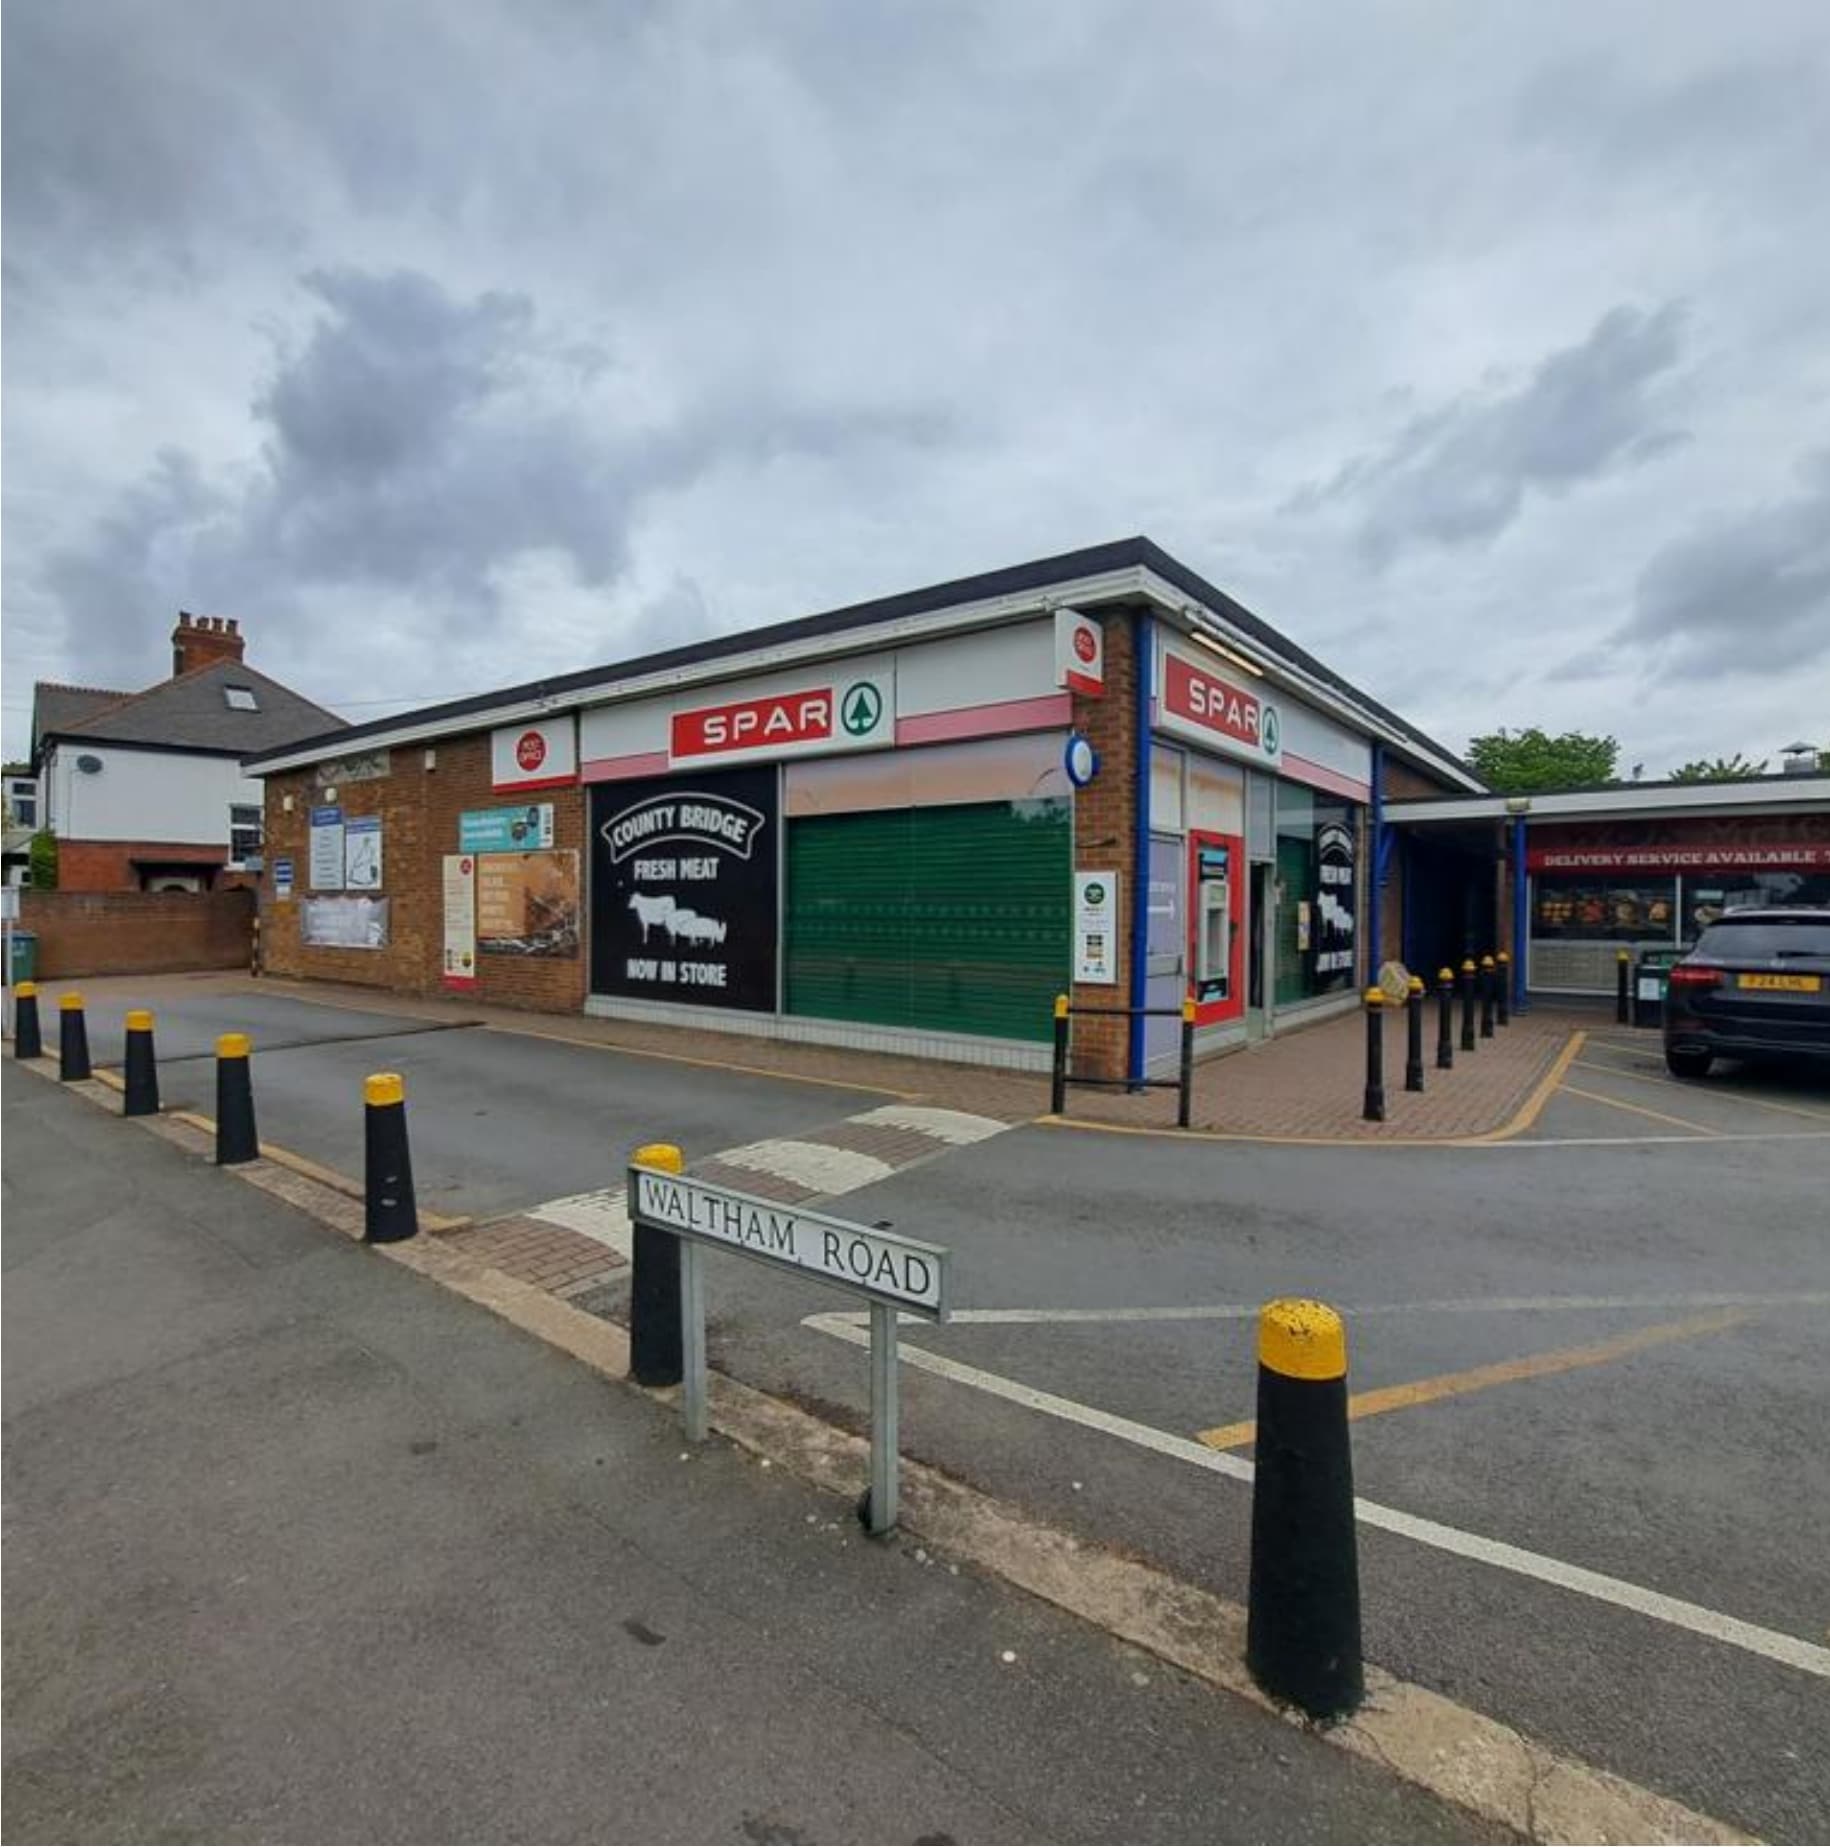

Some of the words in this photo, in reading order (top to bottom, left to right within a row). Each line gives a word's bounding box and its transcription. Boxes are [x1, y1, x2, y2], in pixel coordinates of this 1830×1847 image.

[703, 699, 828, 745] SPAR
[1188, 677, 1259, 737] SPAR
[613, 806, 676, 847] COUNTY
[680, 804, 749, 843] BRIDGE
[633, 859, 677, 880] FRESH
[680, 857, 720, 880] MEAT
[1544, 854, 1623, 867] DELIVERY
[1626, 852, 1700, 865] SERVICE
[1705, 849, 1816, 864] AVAILABLE
[627, 958, 658, 980] NOW
[661, 960, 676, 982] IN
[679, 961, 727, 987] STORE
[644, 1178, 796, 1256] WALTHAM
[823, 1230, 931, 1295] ROAD
